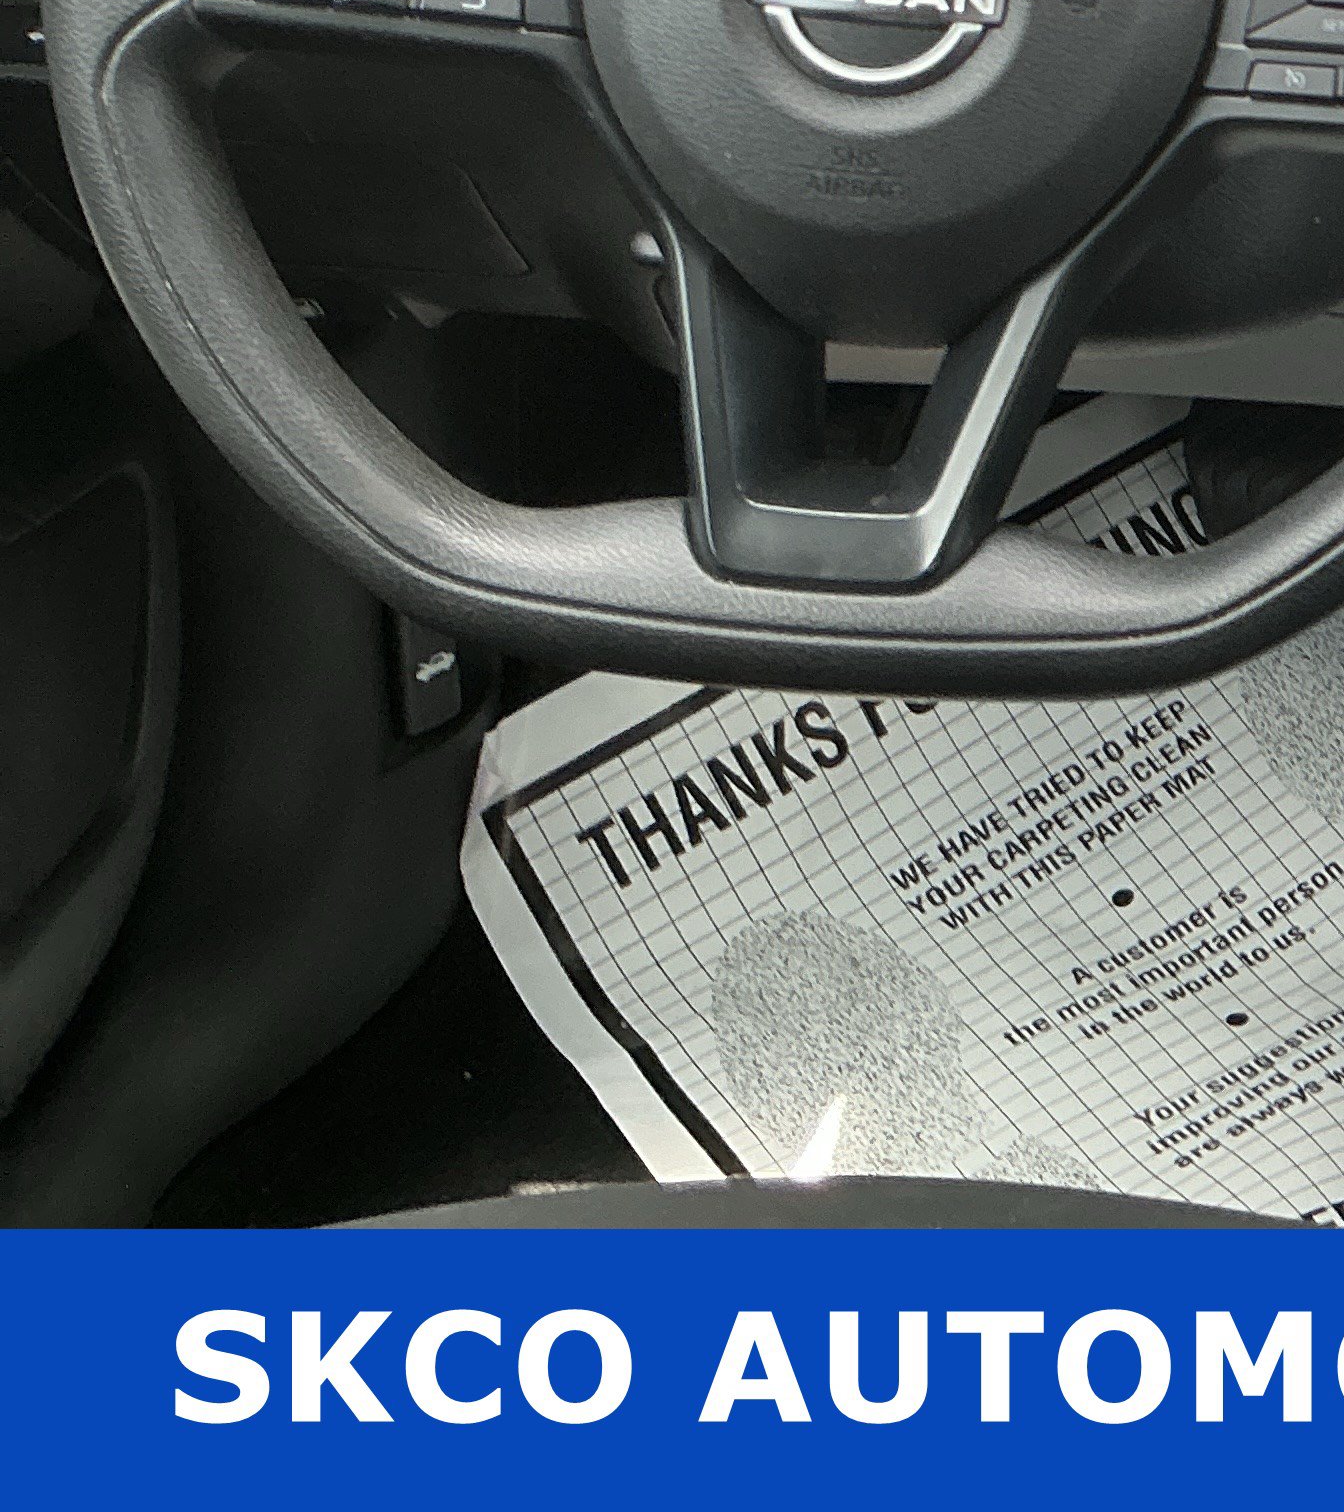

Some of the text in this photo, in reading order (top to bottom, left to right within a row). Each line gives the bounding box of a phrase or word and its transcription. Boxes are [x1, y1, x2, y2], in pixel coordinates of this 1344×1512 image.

[577, 701, 848, 888] THANKS
[890, 699, 1187, 890] WE HAVE TRIED TO KEEP
[906, 723, 1213, 915] YOUR CARPETING CLEAN
[939, 755, 1216, 931] WITH THIS PAPER MAT
[1003, 1016, 1052, 1047] the
[1056, 982, 1126, 1024] most
[1125, 915, 1258, 990] important
[1071, 886, 1249, 986] A customer is
[1111, 998, 1159, 1026] the
[1162, 960, 1239, 1003] world
[1238, 946, 1270, 967] to
[1274, 924, 1317, 952] us.
[1133, 1089, 1200, 1127] Your
[1146, 1069, 1291, 1156] improving
[1291, 1041, 1337, 1073] our
[1174, 1137, 1222, 1169] are
[1225, 1079, 1325, 1138] always
